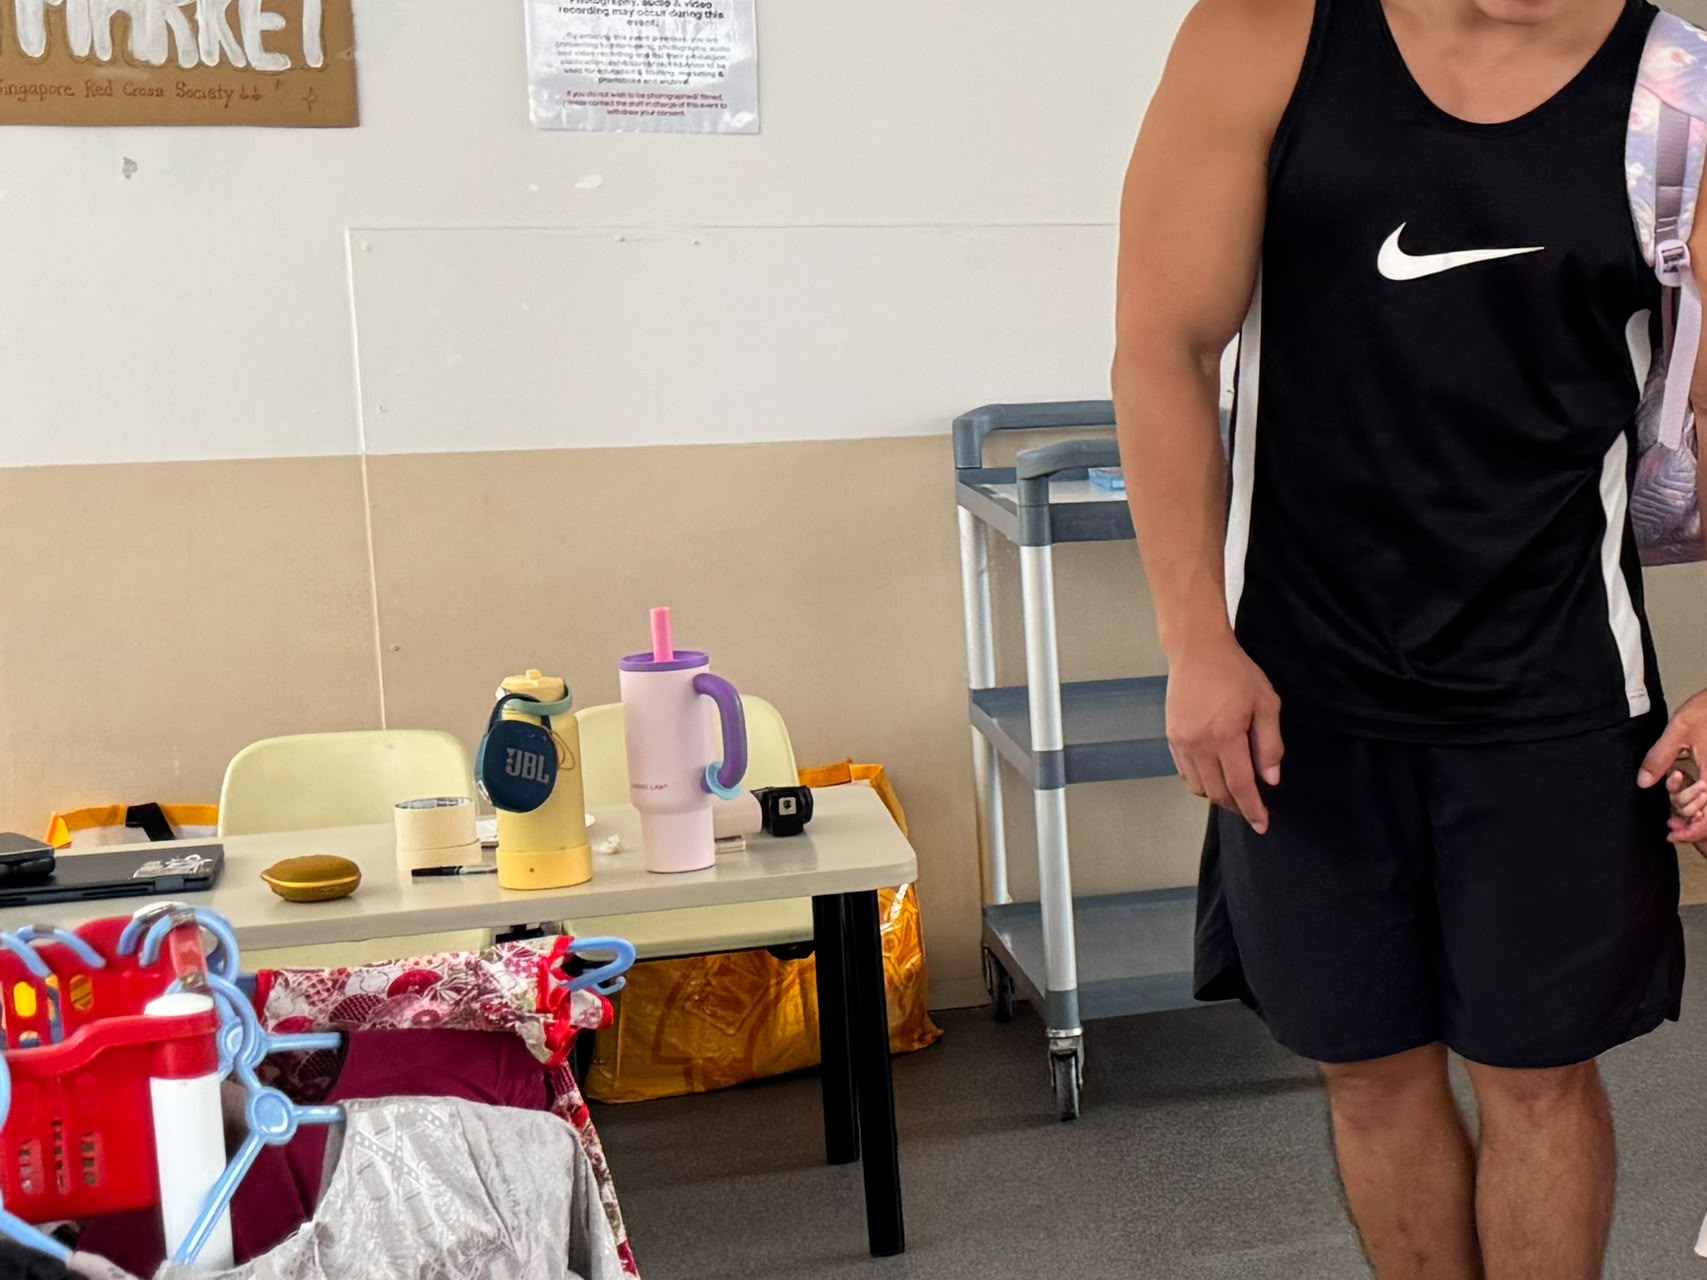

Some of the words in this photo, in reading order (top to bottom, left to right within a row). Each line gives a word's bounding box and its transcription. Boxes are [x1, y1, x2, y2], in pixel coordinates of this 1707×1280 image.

[84, 79, 114, 99] Red
[122, 80, 165, 98] Cross
[175, 80, 235, 109] Society
[507, 748, 550, 785] JBL
